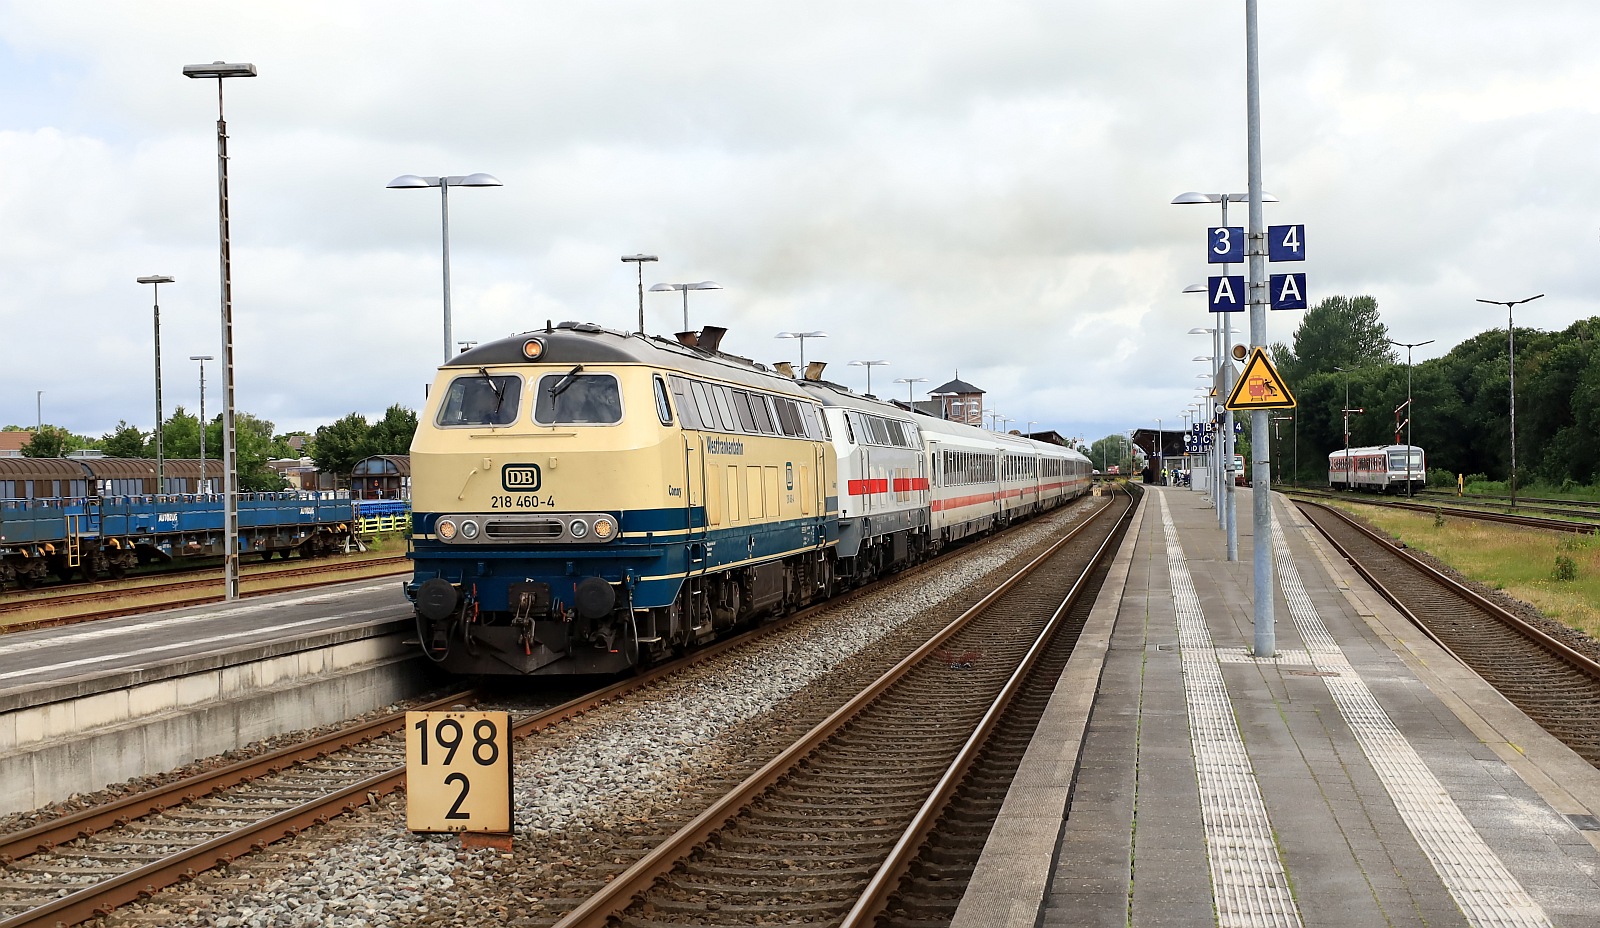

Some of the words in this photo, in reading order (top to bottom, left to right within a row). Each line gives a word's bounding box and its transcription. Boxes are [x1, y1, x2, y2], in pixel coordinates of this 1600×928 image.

[1213, 227, 1231, 255] 3
[1282, 225, 1300, 253] 4
[1213, 277, 1236, 304] A
[1279, 274, 1302, 302] A
[706, 436, 744, 455] Westfrankenbahn
[508, 470, 533, 485] DB
[299, 507, 315, 515] AUTOZUG
[491, 495, 512, 509] 218
[516, 495, 555, 508] 460-4
[158, 512, 178, 522] AUTOZUG
[415, 718, 499, 766] 198
[443, 772, 470, 820] 2
